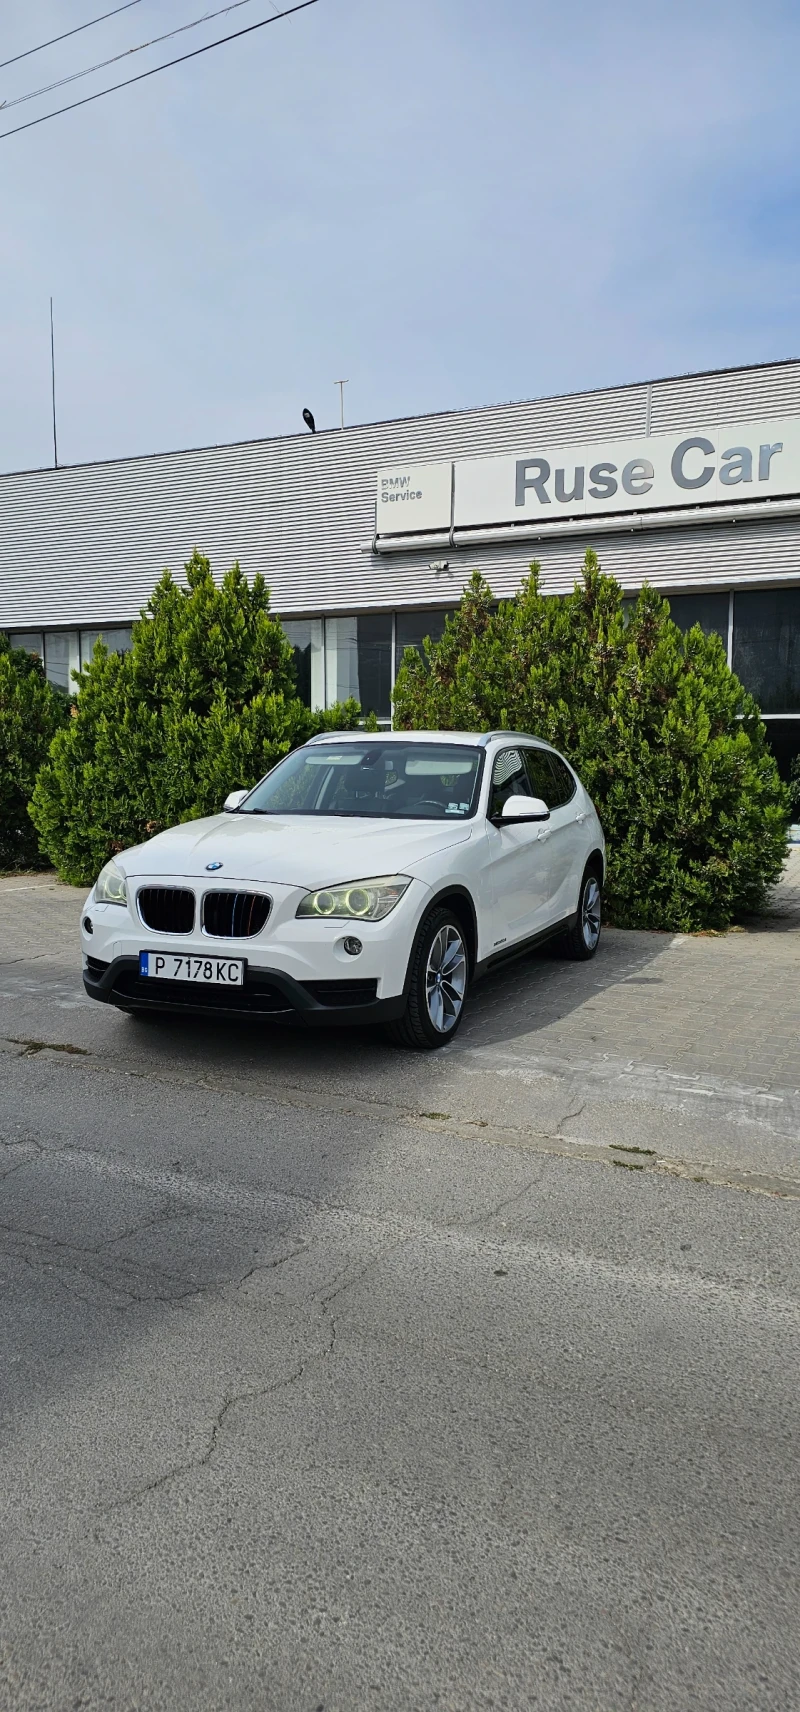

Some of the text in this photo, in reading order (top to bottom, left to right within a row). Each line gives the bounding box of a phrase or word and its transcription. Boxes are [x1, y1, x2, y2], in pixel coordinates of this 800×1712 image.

[514, 437, 783, 506] Ruse Car
[381, 476, 411, 490] BMW
[381, 490, 423, 503] Service
[155, 957, 165, 975] P
